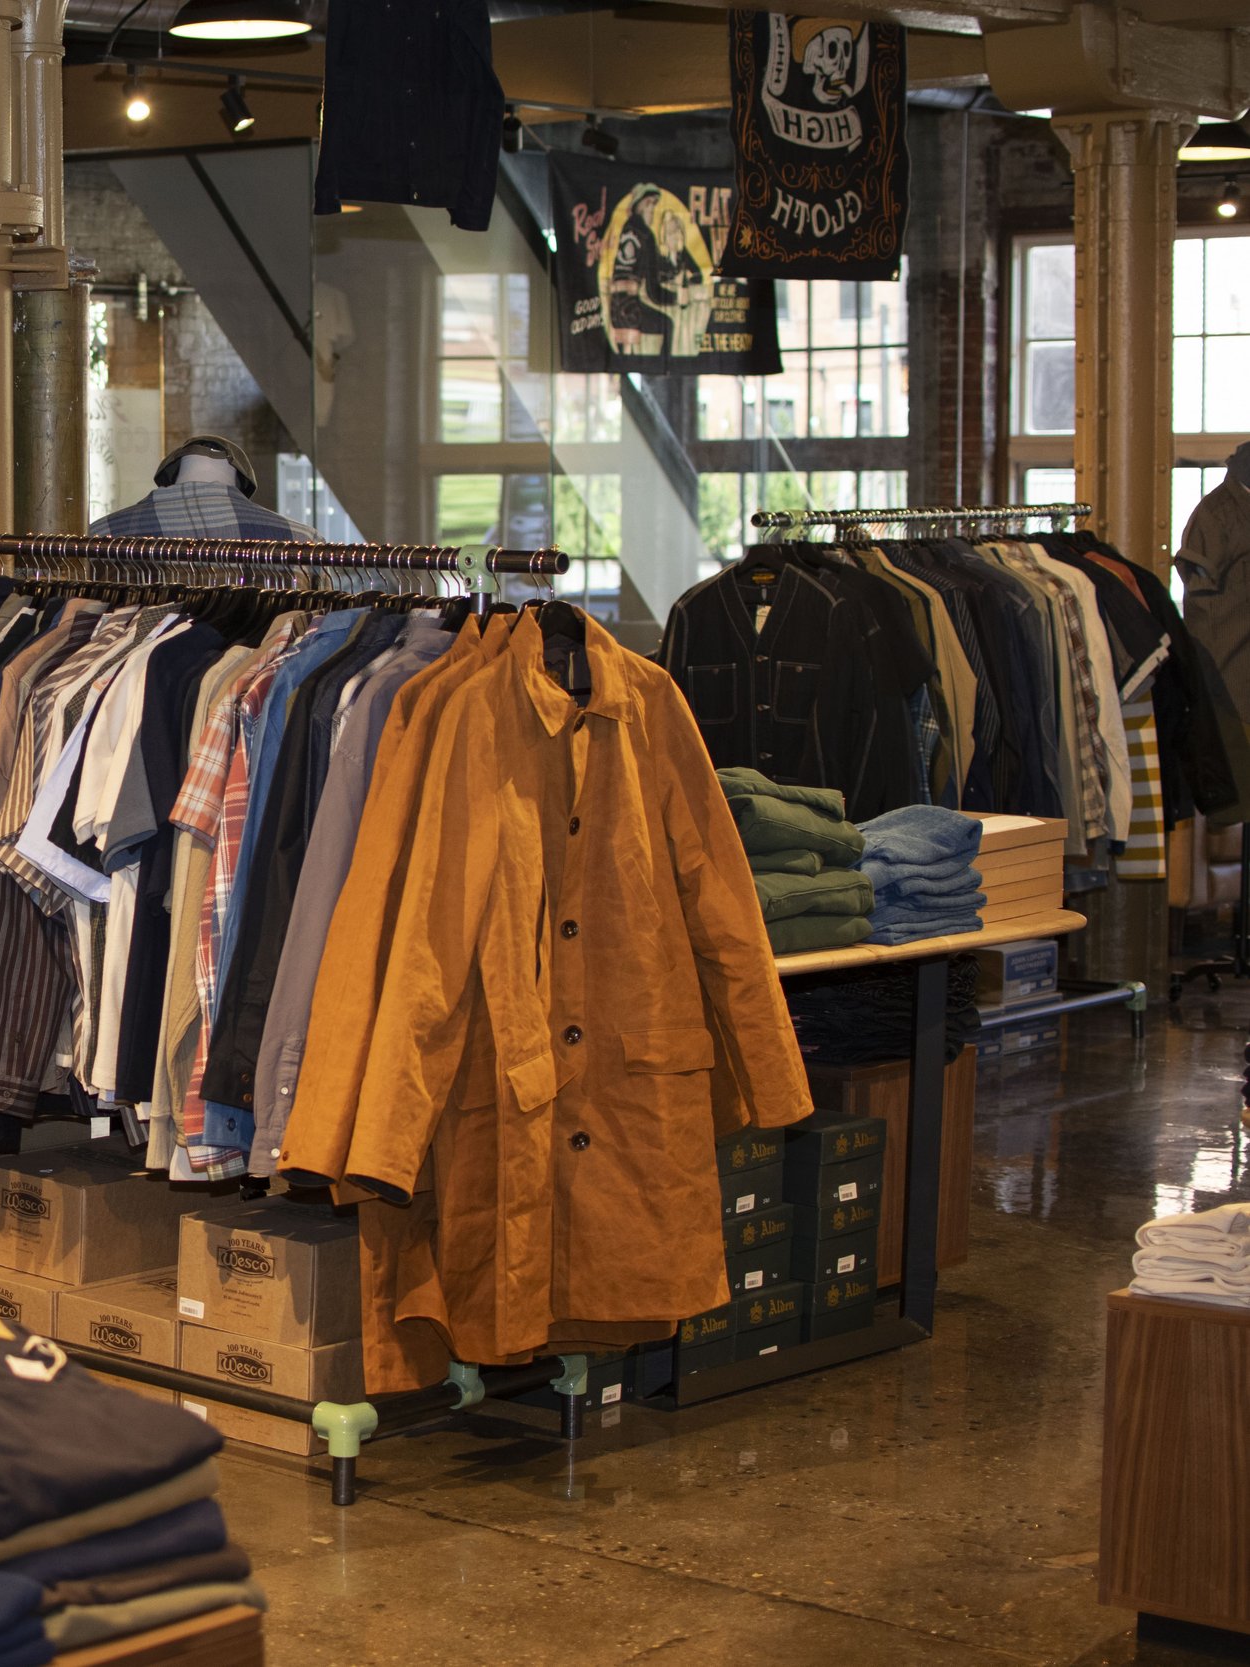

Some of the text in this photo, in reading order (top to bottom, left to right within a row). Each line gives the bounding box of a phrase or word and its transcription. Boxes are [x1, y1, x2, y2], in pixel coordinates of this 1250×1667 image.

[689, 185, 732, 226] FLAT
[574, 296, 600, 316] GOOD
[751, 1143, 777, 1160] Alden
[5, 1194, 46, 1214] Wesco
[227, 1239, 266, 1254] 100 YEARS
[222, 1252, 270, 1273] Wesco
[768, 1299, 795, 1317] Alden
[99, 1315, 133, 1330] 100 YEARS
[700, 1317, 727, 1336] Alden
[94, 1327, 138, 1348] Wesco
[226, 1344, 263, 1360] 100 YEARS
[221, 1357, 268, 1378] Wesco
